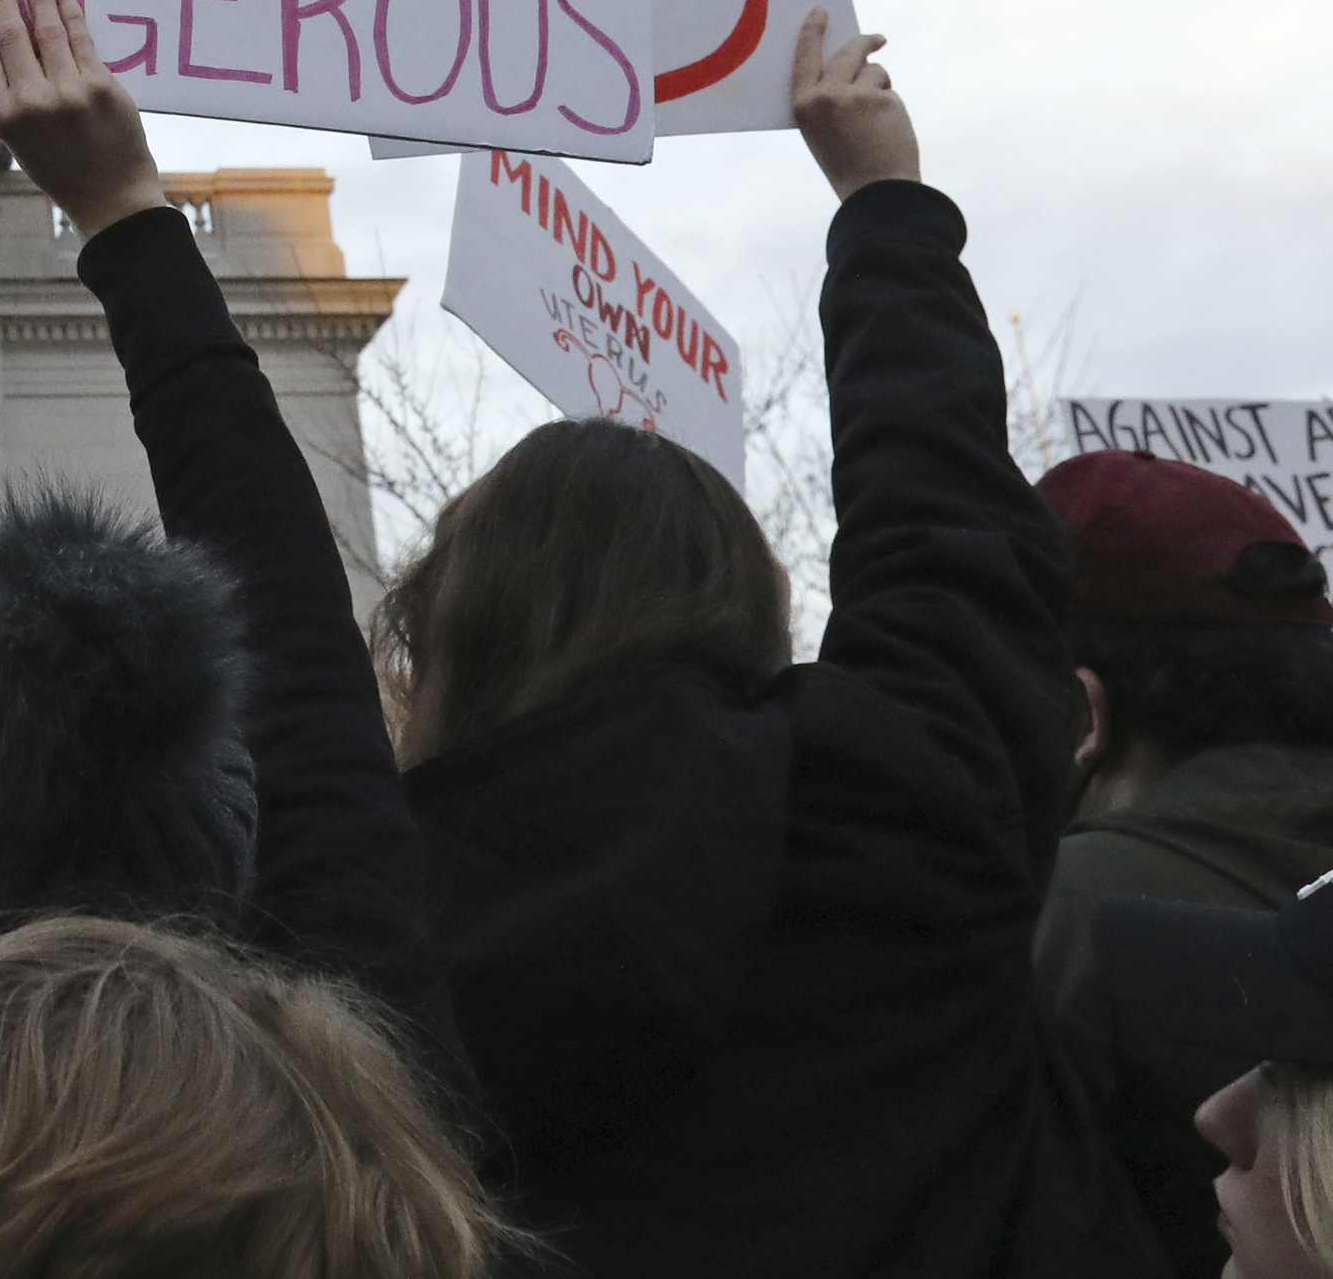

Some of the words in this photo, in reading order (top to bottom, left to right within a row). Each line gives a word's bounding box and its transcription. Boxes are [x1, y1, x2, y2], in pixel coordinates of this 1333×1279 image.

[490, 148, 617, 284] MIND
[632, 260, 729, 404] YOUR
[572, 263, 651, 365] OWN
[539, 288, 667, 415] UTERUS
[1069, 400, 1271, 465] AGAINST
